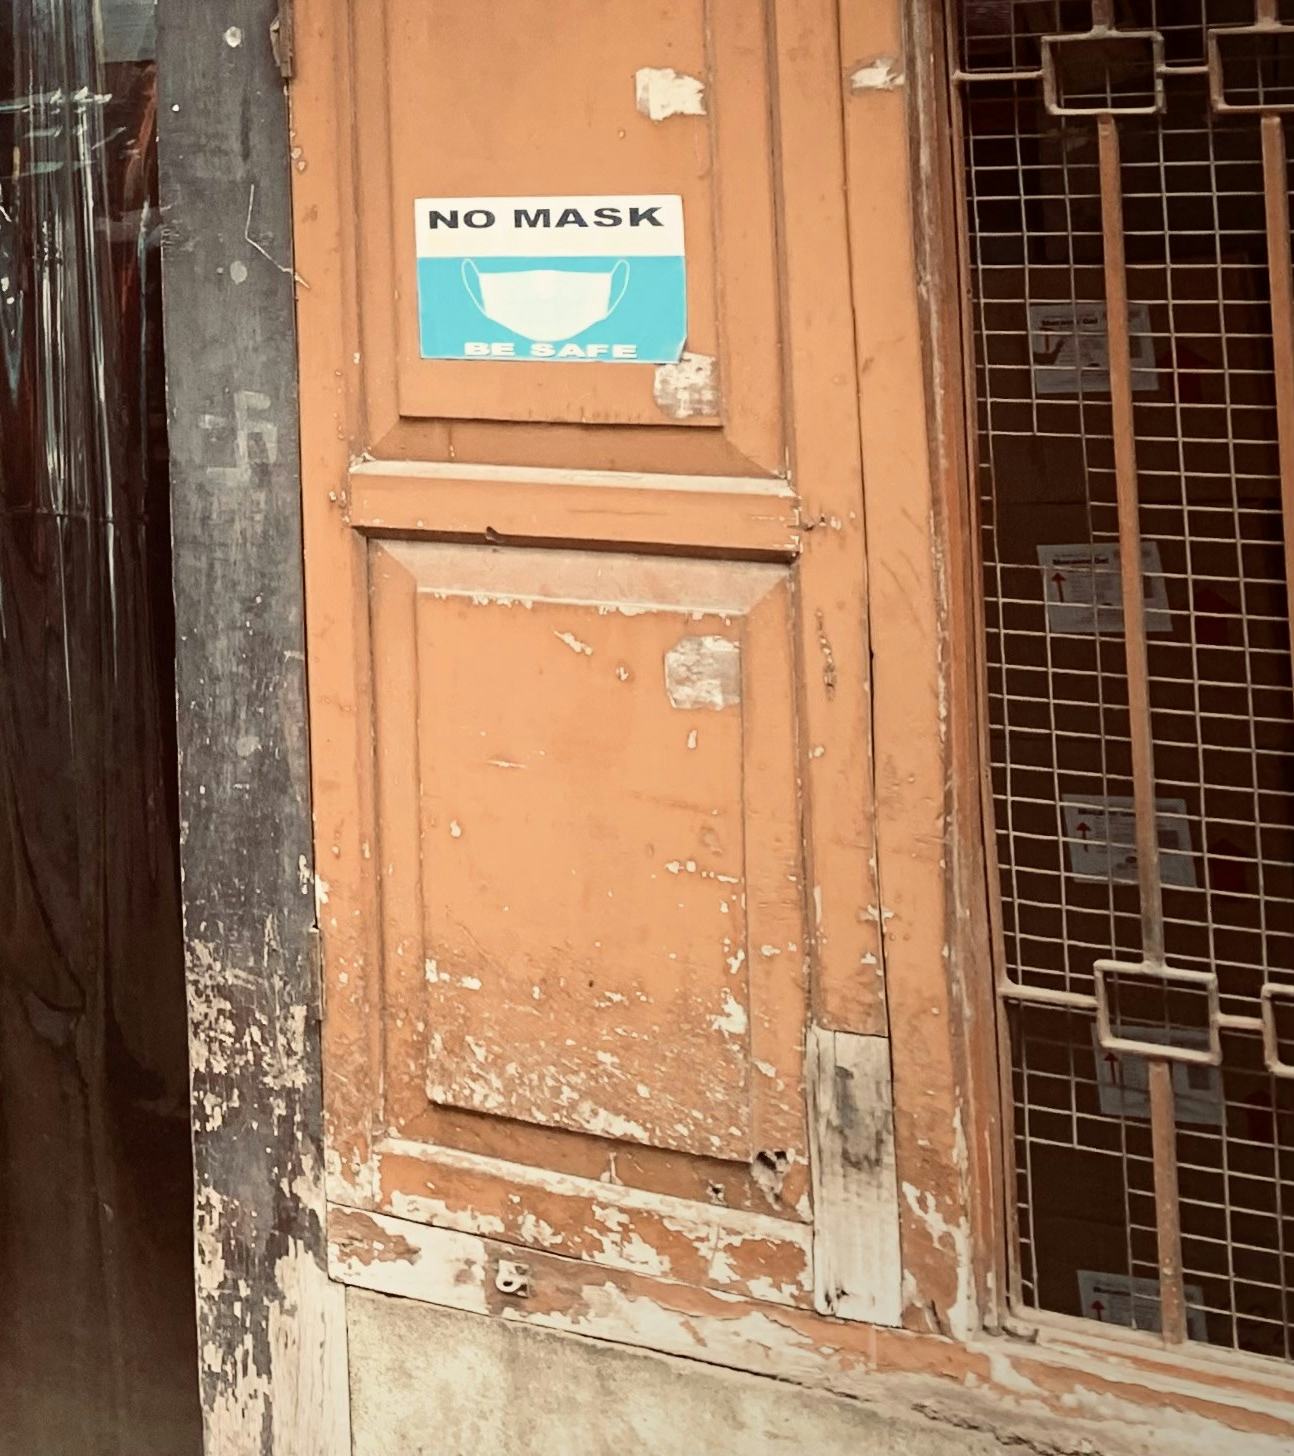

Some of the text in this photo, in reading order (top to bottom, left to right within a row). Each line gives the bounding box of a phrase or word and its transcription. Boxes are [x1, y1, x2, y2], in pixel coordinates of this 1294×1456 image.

[428, 206, 665, 230] NO MASK
[464, 342, 638, 359] BE SAFE
